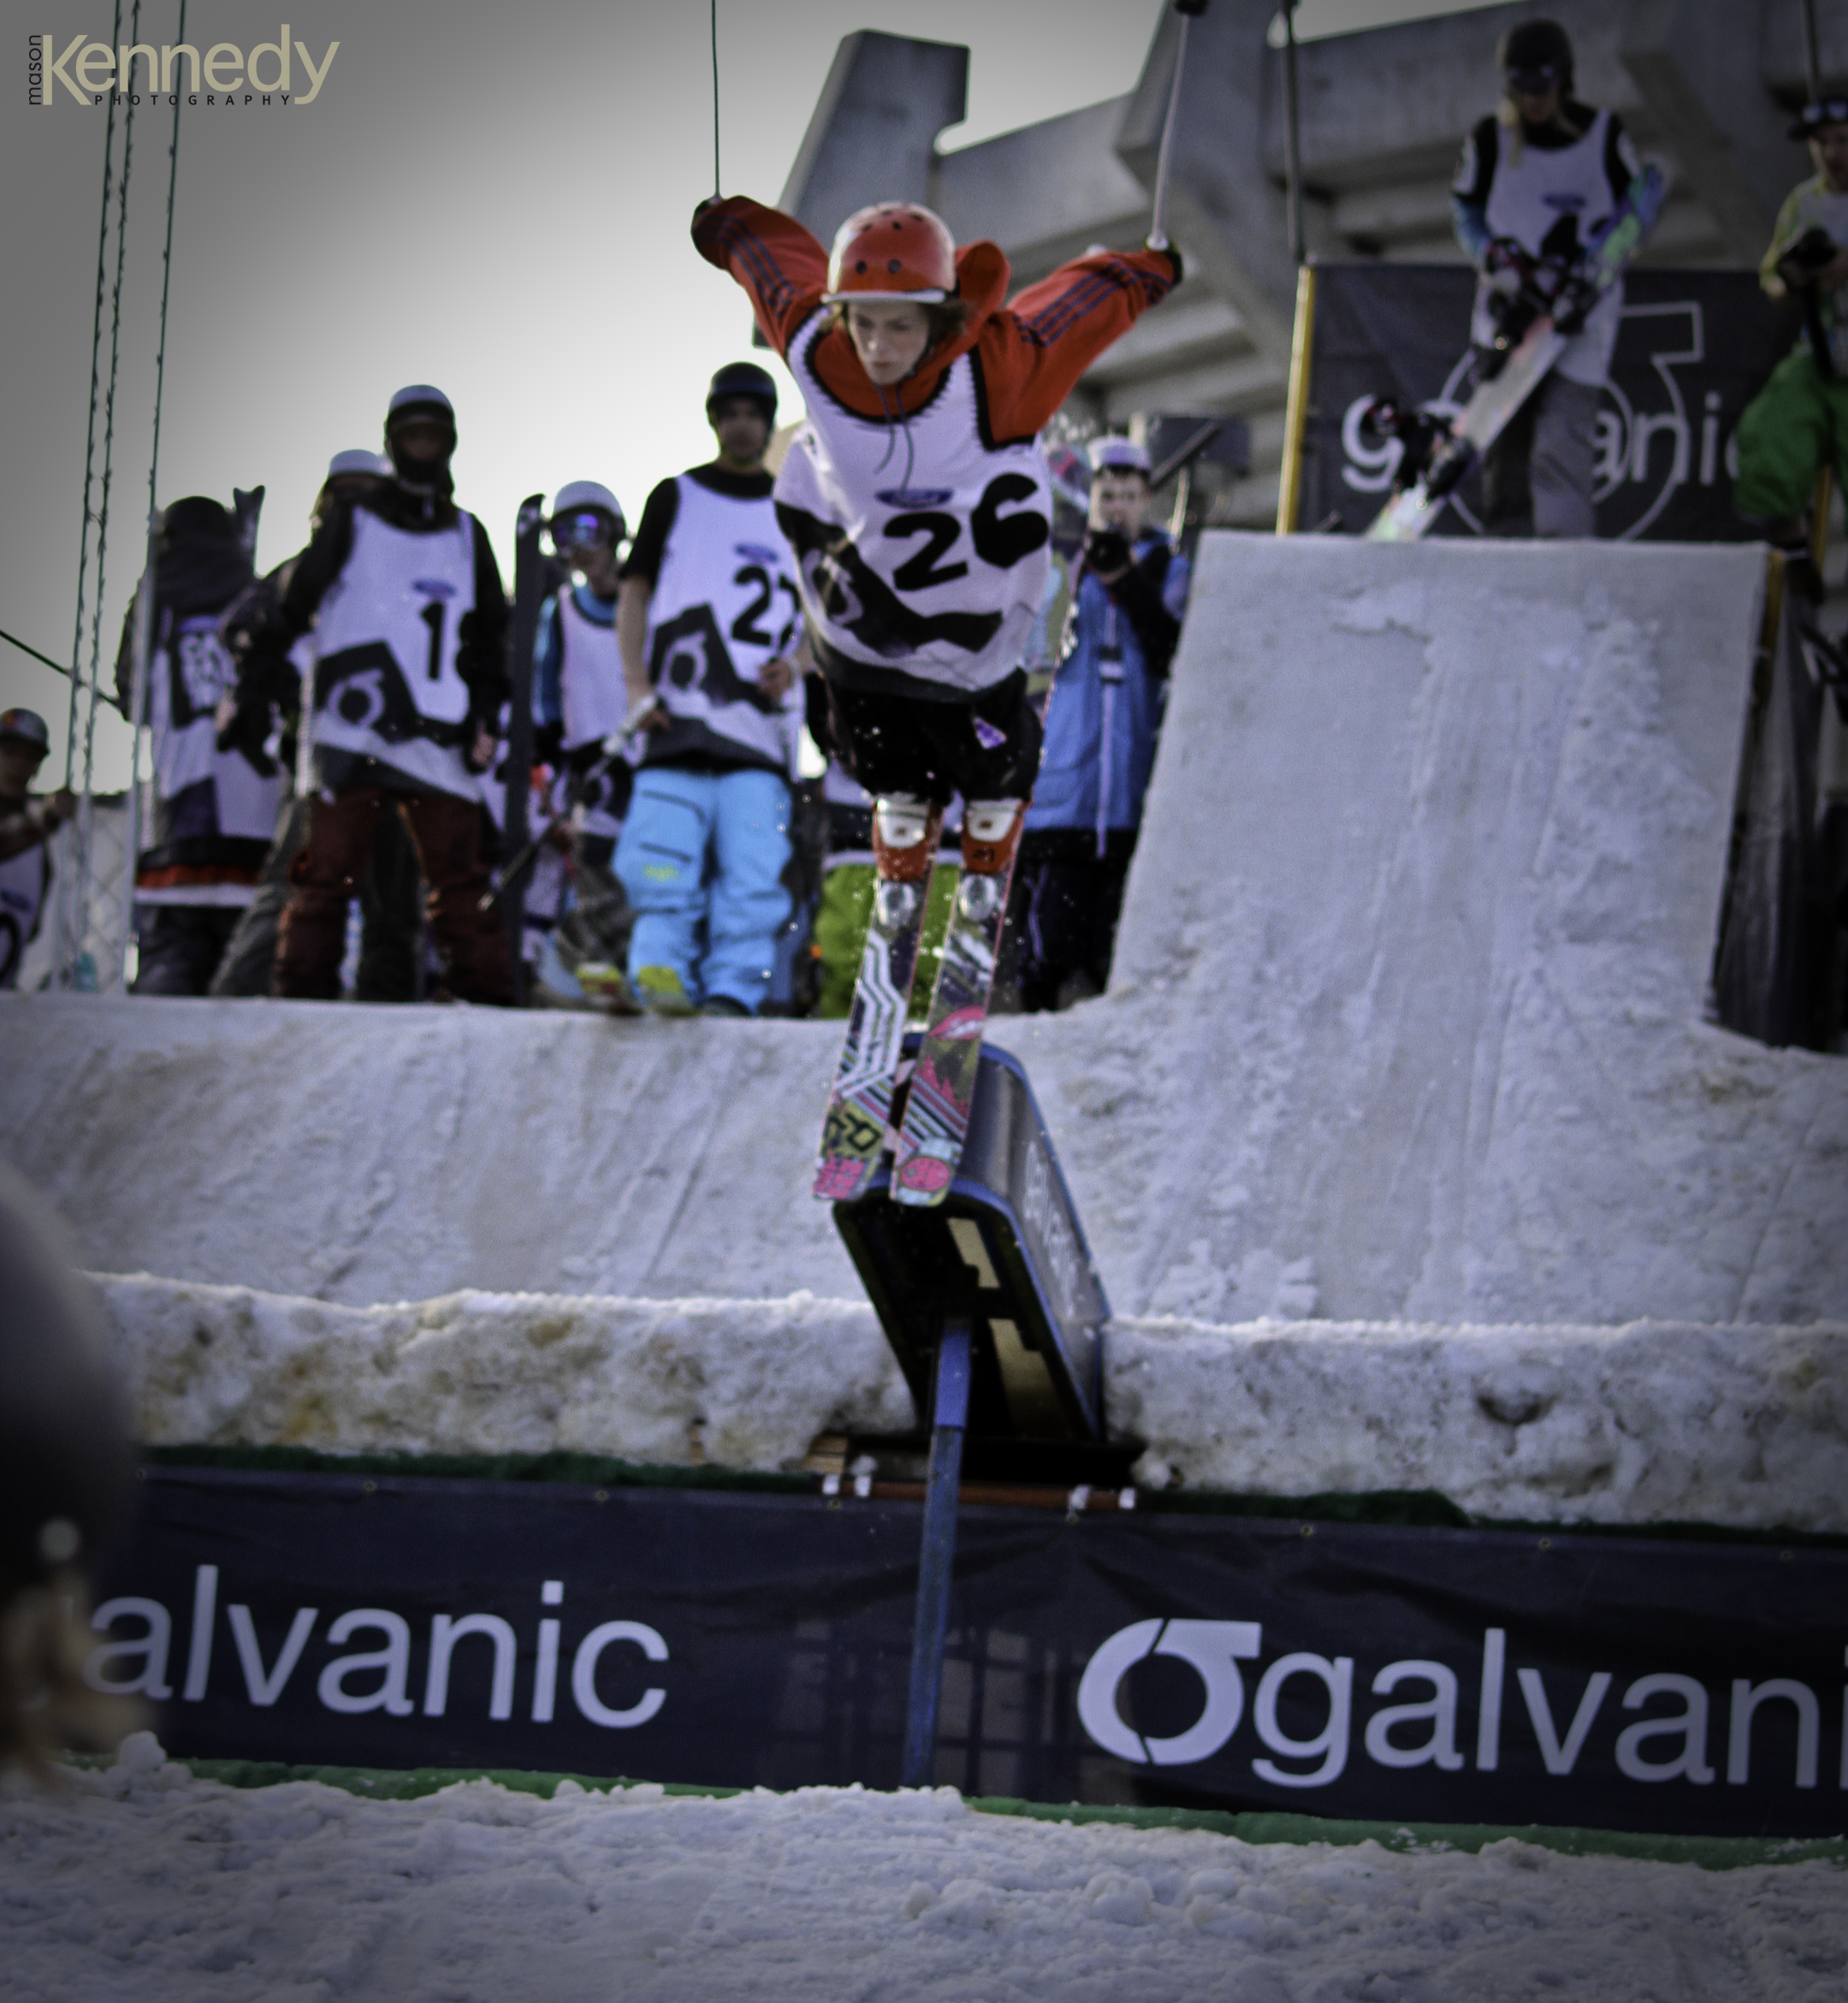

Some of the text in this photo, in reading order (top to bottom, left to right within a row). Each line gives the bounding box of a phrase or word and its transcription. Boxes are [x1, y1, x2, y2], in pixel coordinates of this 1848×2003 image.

[883, 471, 1050, 592] 26
[419, 601, 446, 682] 1
[80, 1564, 670, 1729] alvanic
